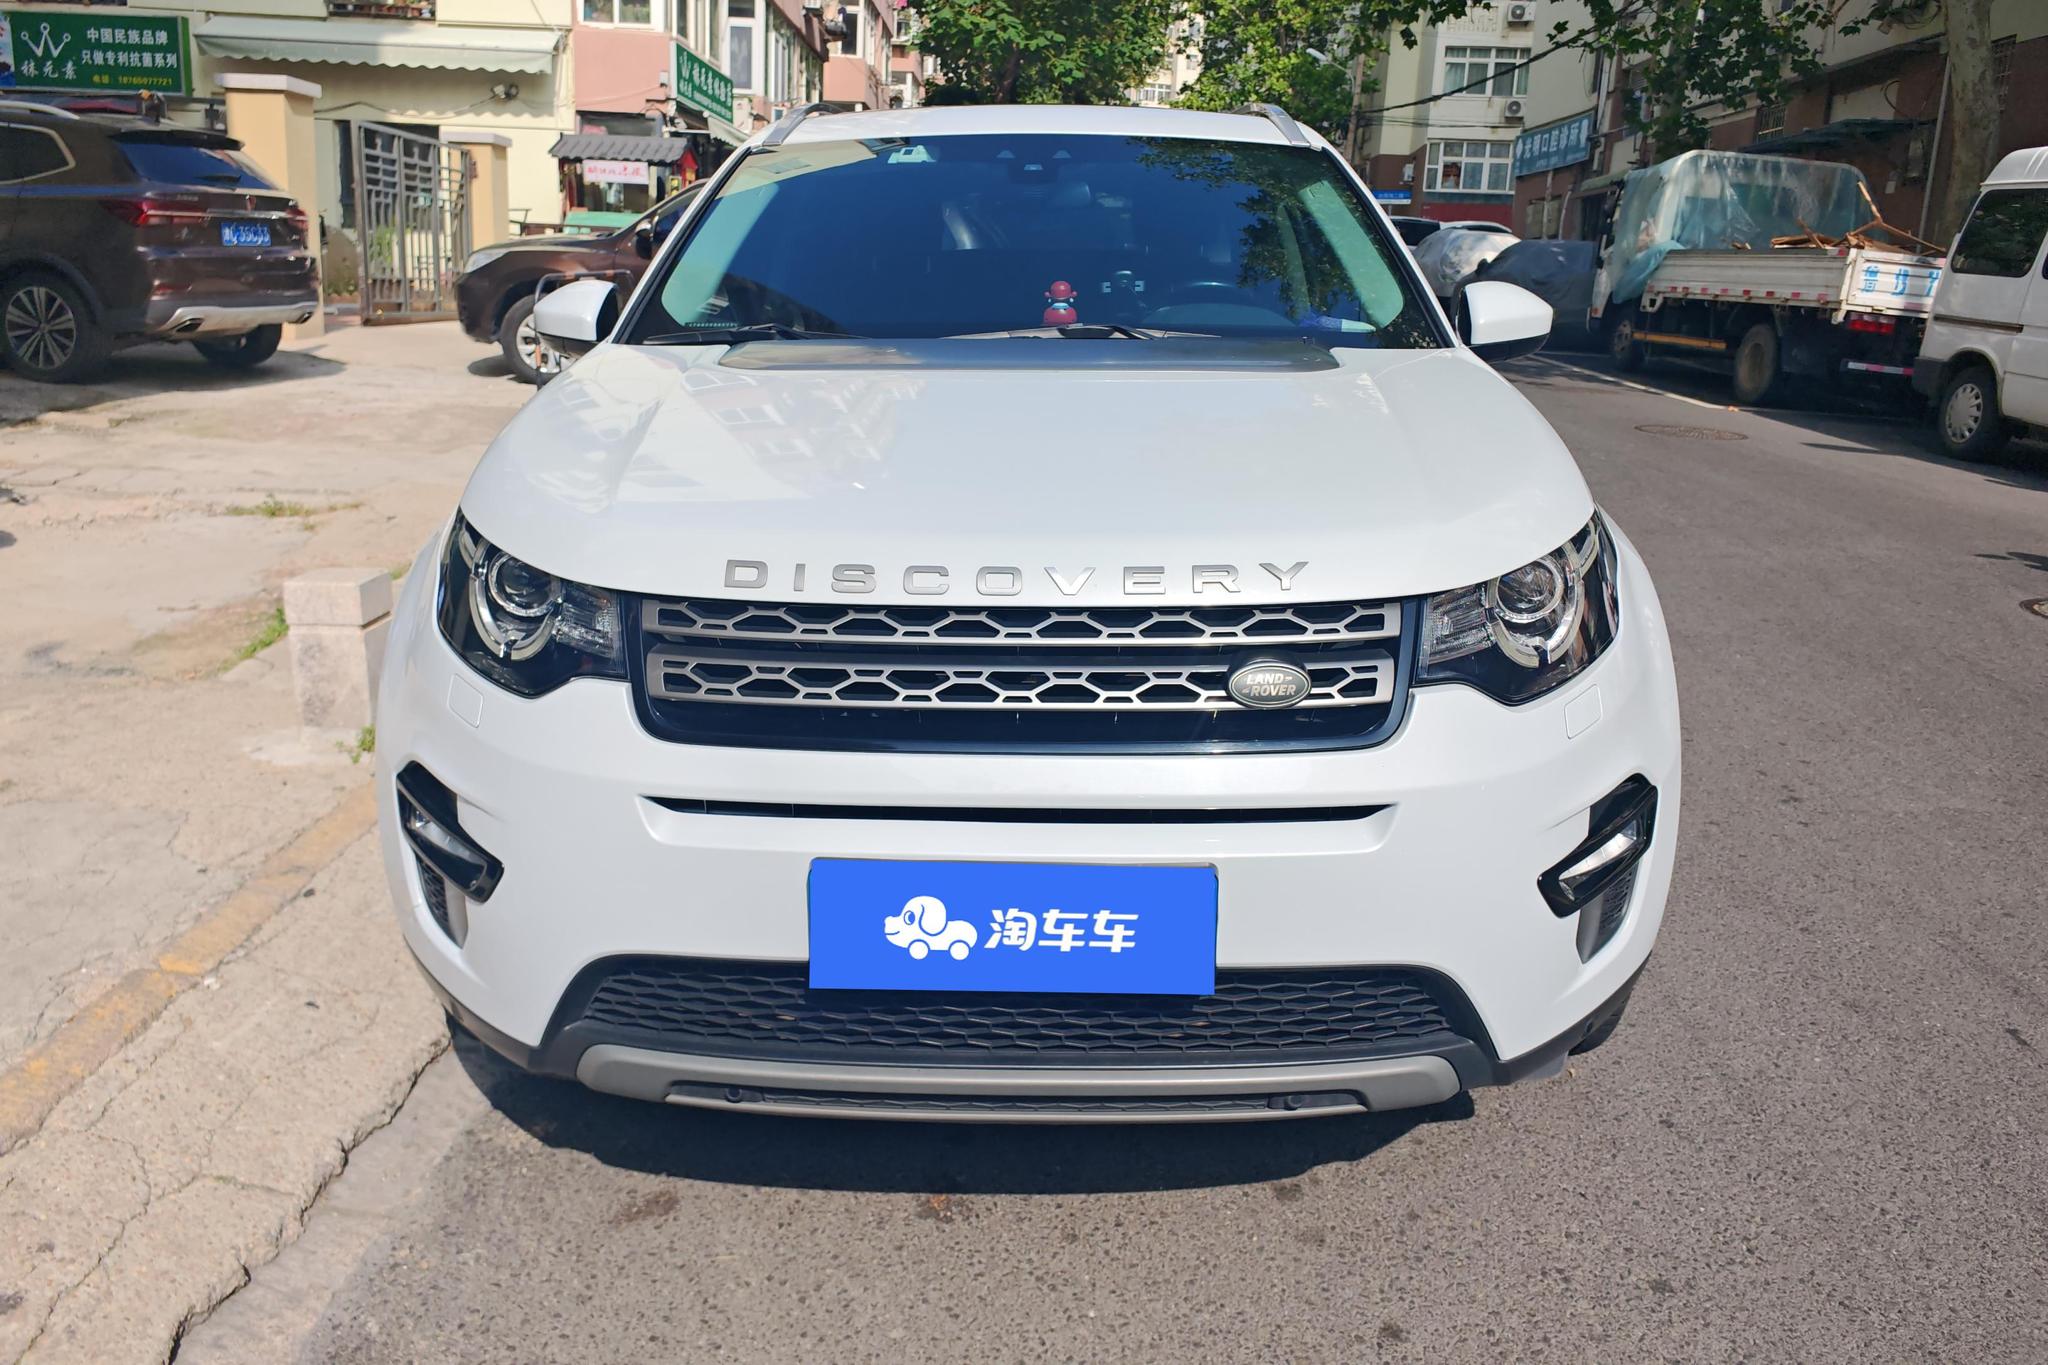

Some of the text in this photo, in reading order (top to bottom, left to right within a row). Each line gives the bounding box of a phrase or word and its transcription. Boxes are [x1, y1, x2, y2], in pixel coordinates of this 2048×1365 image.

[87, 27, 168, 45] 中国民族品牌
[82, 50, 177, 68] 只做专利抗菌系列
[1524, 122, 1579, 159] 光明口腔诊所
[724, 559, 1309, 596] DISCOVERY
[1247, 673, 1284, 685] LAND
[1250, 684, 1297, 697] ROVER
